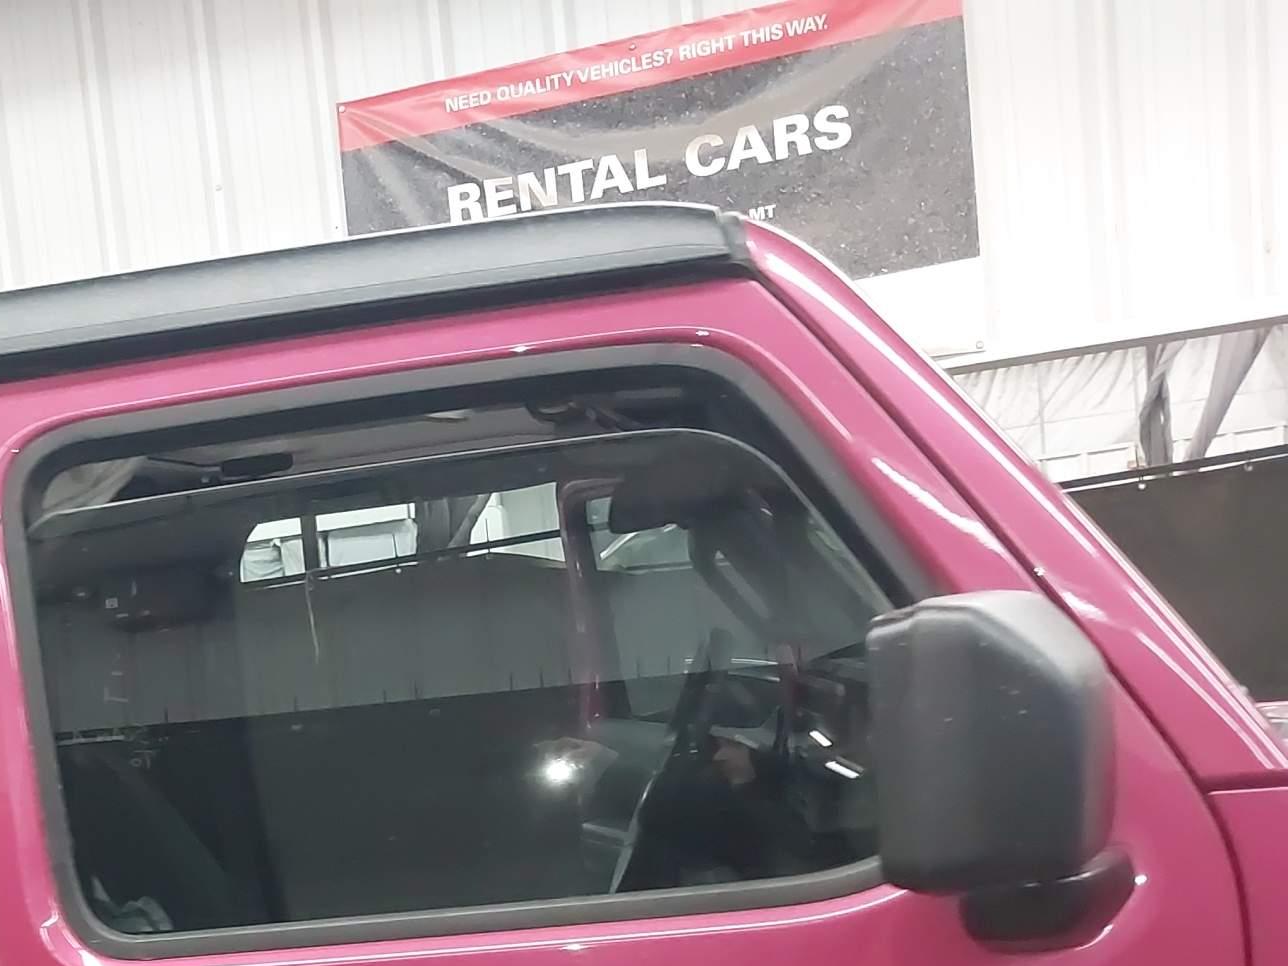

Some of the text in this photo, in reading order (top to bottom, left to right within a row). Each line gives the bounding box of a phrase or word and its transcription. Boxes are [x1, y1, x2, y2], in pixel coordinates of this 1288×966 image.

[444, 14, 829, 113] NEED QUALITY VEHICLES? RIGHT THIS WAY.
[446, 104, 853, 224] RENTAL CARS
